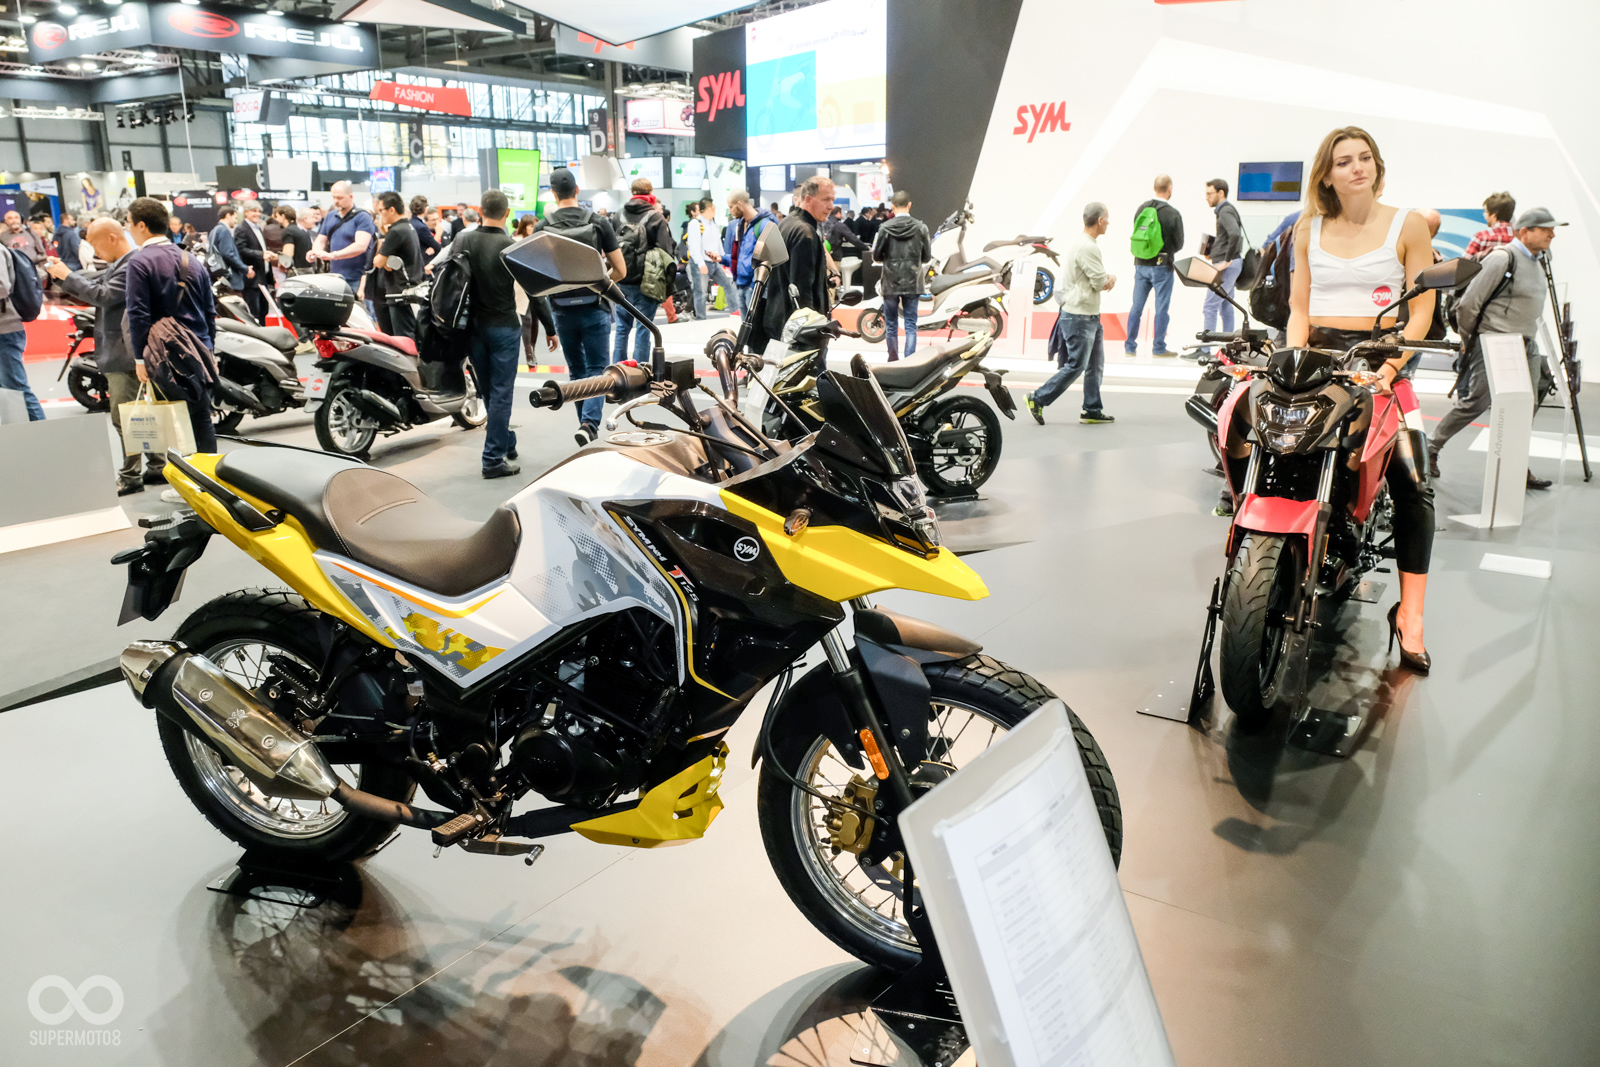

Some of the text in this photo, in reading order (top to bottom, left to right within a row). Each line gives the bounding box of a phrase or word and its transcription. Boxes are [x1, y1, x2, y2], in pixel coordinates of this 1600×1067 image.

[68, 13, 139, 41] RIEJU
[243, 22, 362, 51] RIEJU
[394, 87, 434, 103] FASHION
[696, 69, 746, 122] SYM
[235, 101, 259, 113] DOGA
[592, 112, 599, 123] 9
[1013, 101, 1071, 144] SYM
[410, 138, 423, 159] C
[590, 131, 606, 153] D
[1372, 292, 1392, 304] SYM
[1494, 407, 1505, 457] Adventure
[623, 516, 652, 545] SYM
[680, 581, 700, 602] 125
[736, 542, 757, 556] SYM
